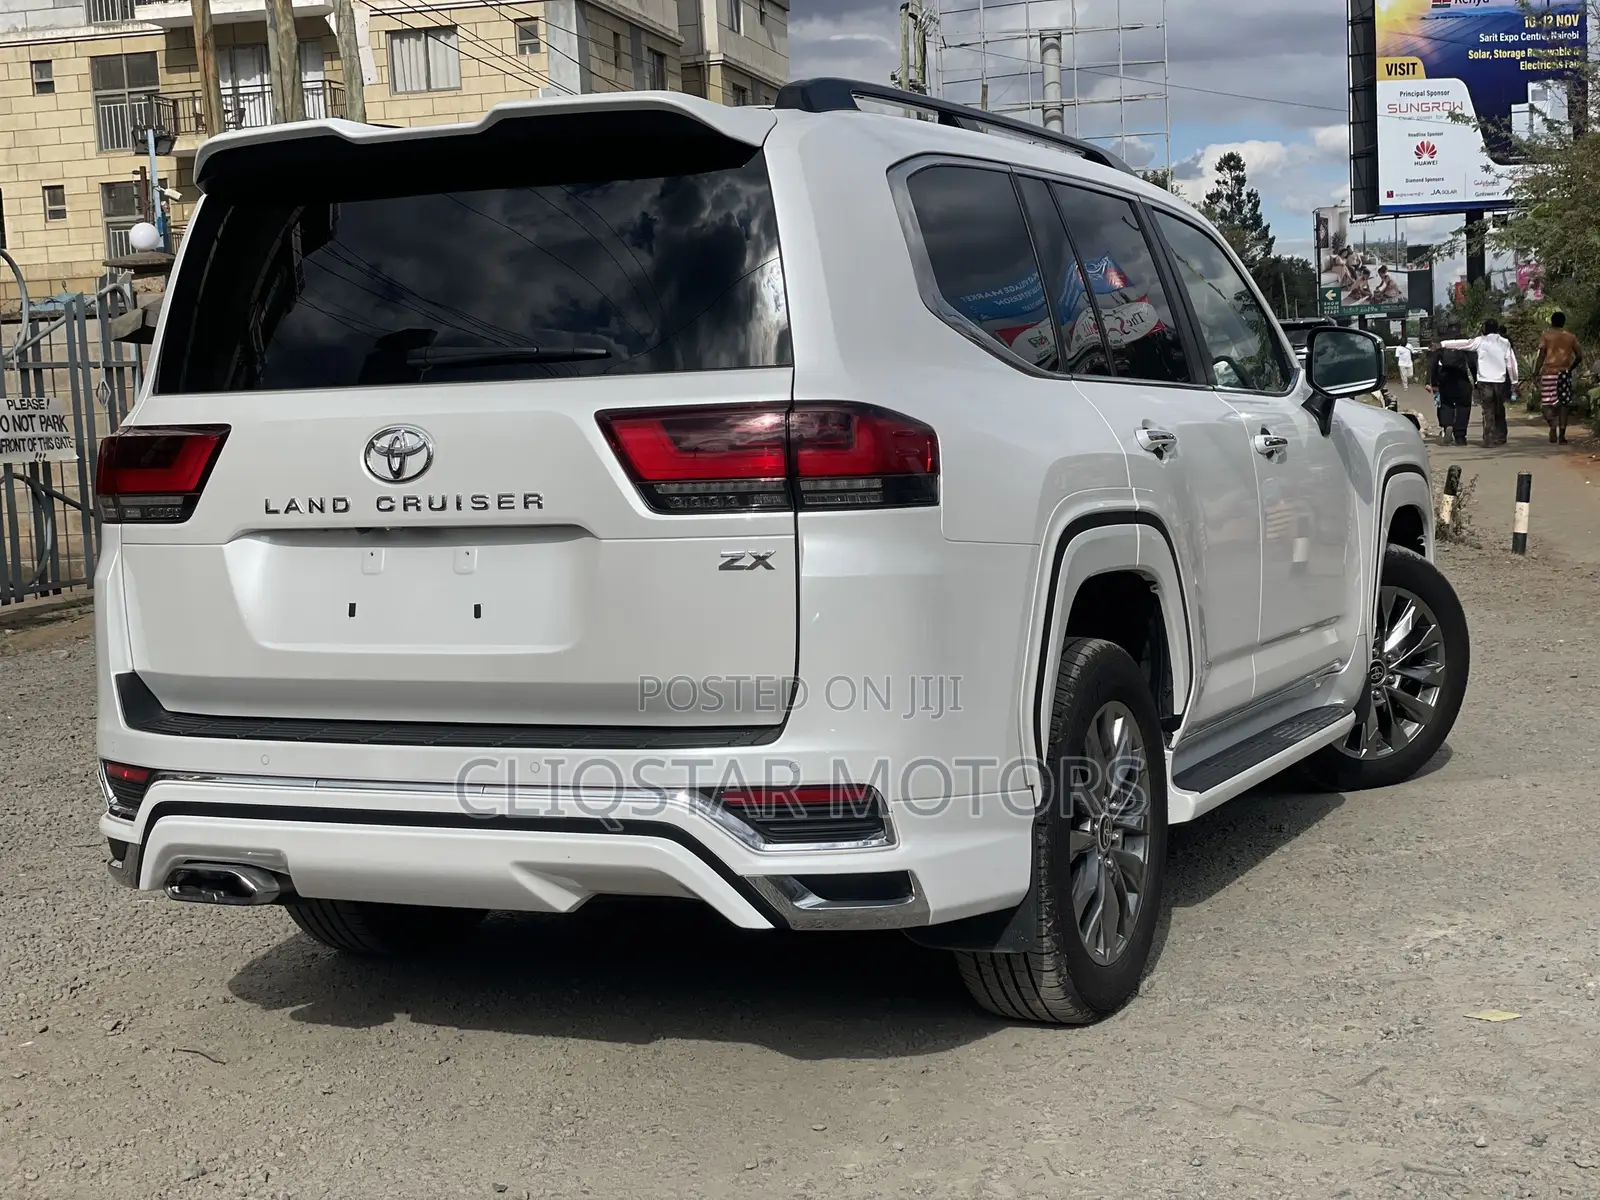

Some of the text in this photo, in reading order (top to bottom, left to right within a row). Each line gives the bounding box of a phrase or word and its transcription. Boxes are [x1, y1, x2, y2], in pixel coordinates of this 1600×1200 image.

[1556, 14, 1580, 27] NOV
[1479, 33, 1498, 42] Sarit
[1500, 32, 1519, 43] Expo
[1468, 49, 1493, 60] Solar,
[1493, 48, 1526, 60] Storage
[1385, 62, 1418, 76] VISIT
[1399, 90, 1426, 98] Principal
[1387, 101, 1464, 113] SUNGROW
[7, 399, 50, 410] PLEASE!
[0, 414, 69, 432] O NOT PARK
[0, 436, 74, 453] FRONT OF THIS GATE
[264, 493, 544, 514] LAND CRUISER
[718, 550, 776, 570] ZX
